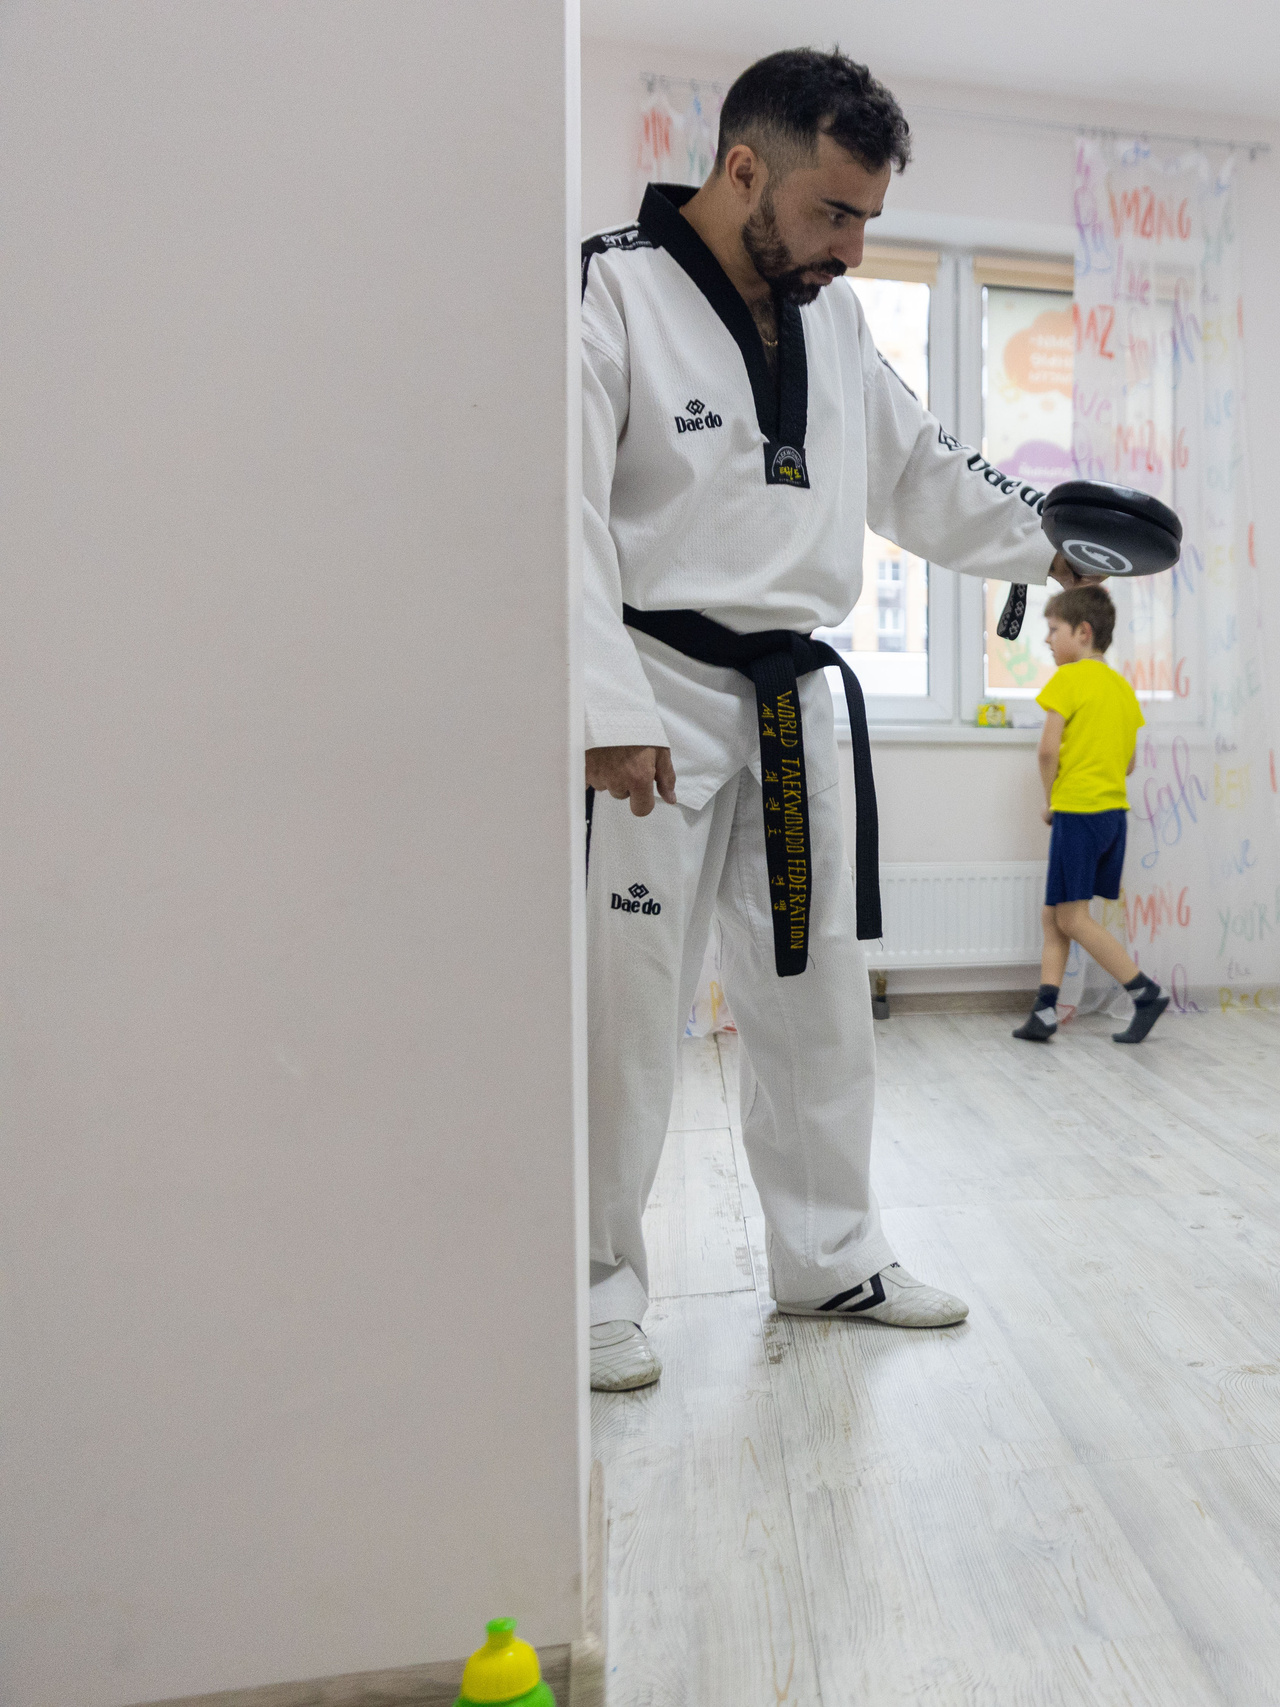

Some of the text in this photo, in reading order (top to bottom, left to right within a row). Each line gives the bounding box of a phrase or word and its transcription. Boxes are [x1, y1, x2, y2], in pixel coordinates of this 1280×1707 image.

[776, 690, 807, 950] WORLD TAEKWONDO FEDERATION
[610, 892, 662, 916] Daedo
